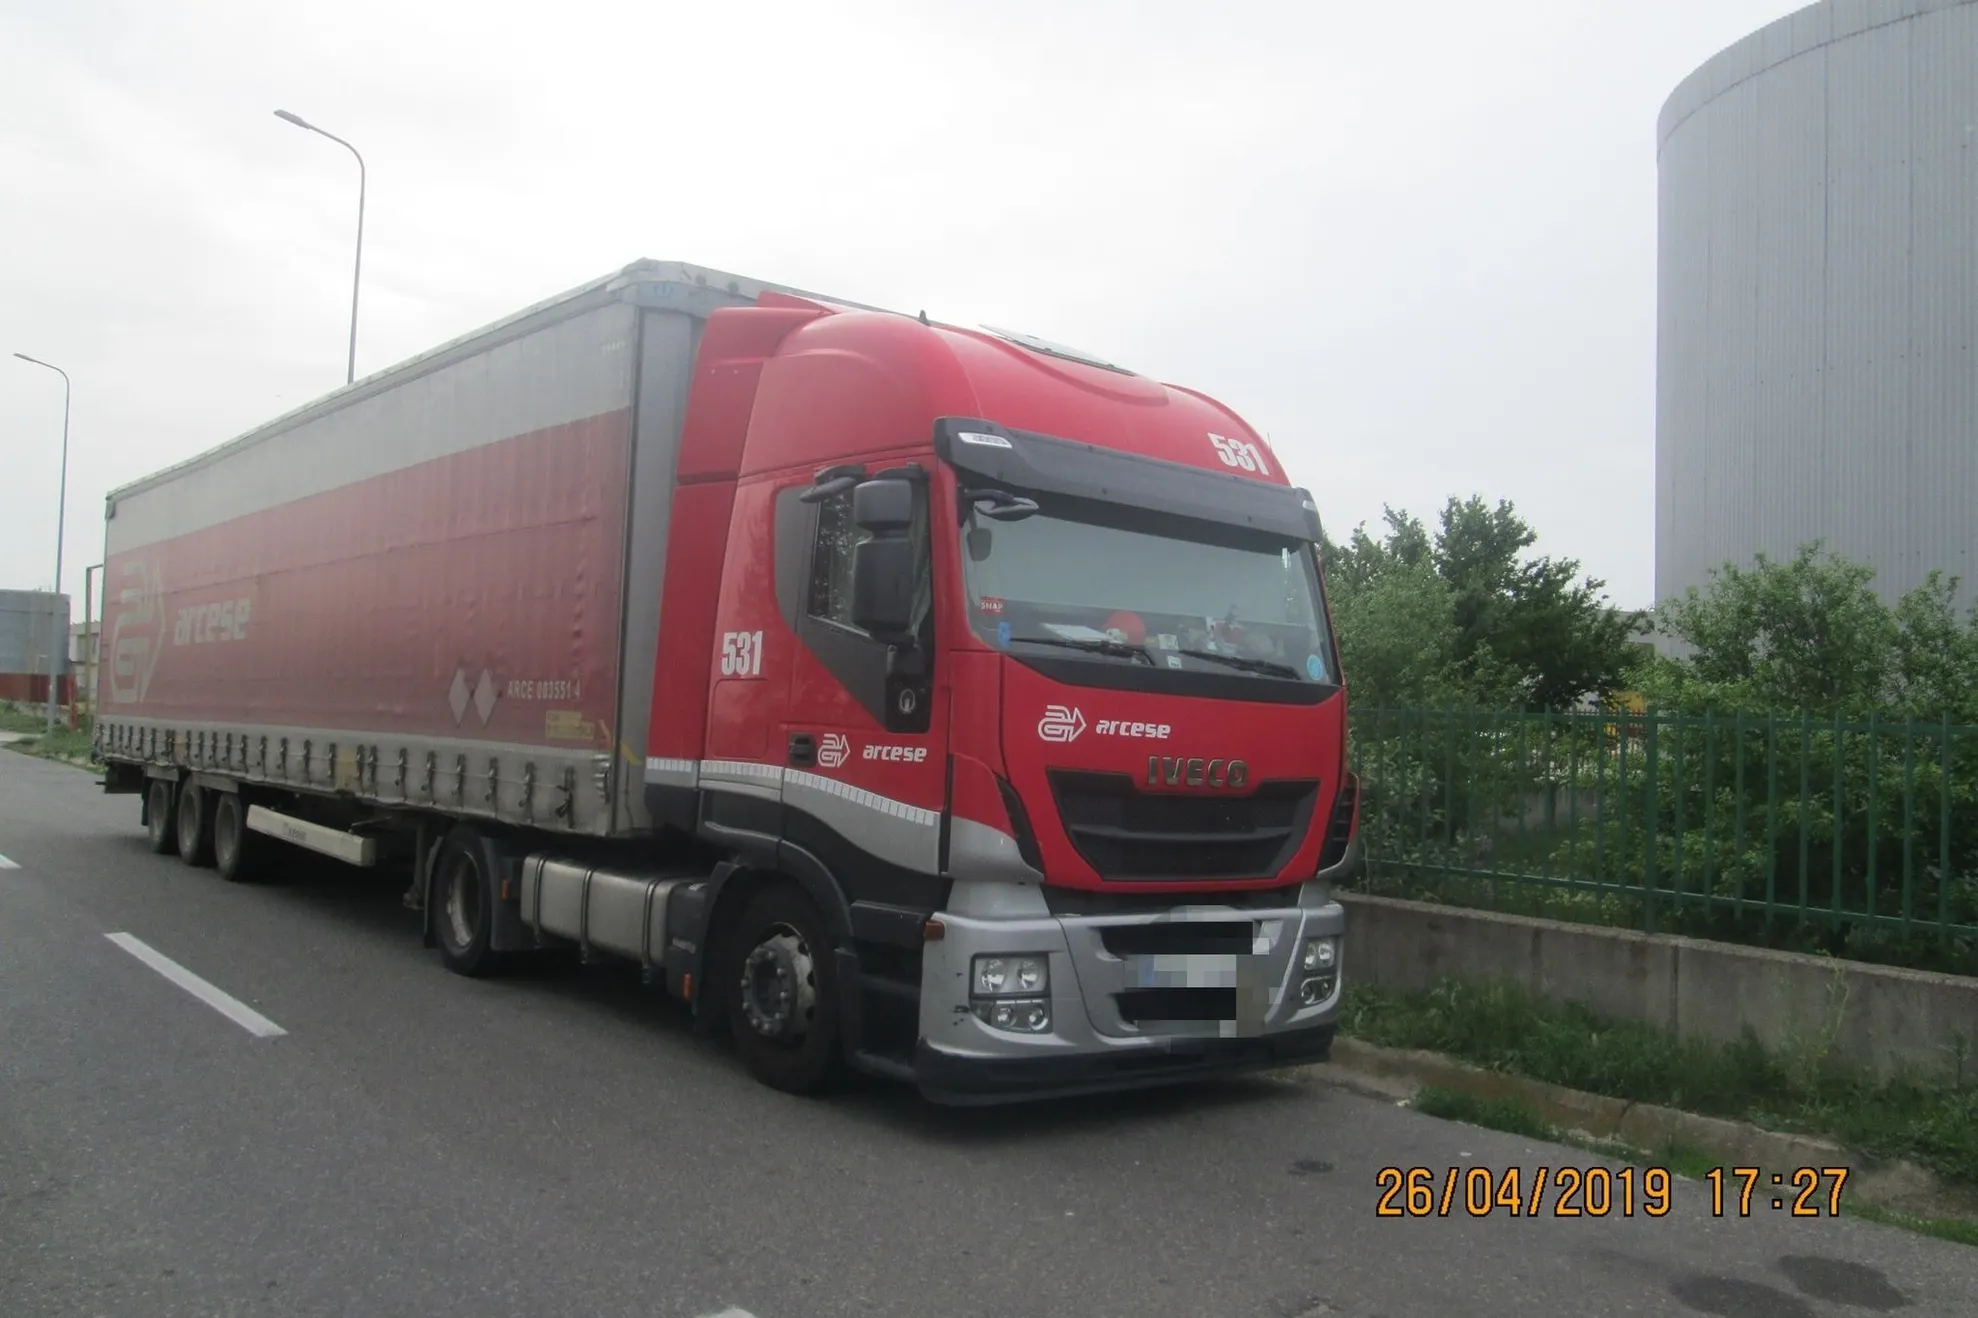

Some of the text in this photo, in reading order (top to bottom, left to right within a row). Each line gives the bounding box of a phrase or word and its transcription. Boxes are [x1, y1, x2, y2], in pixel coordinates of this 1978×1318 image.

[1208, 431, 1270, 475] 531
[174, 598, 250, 645] arcese
[721, 631, 763, 675] 531
[507, 680, 534, 699] ARCE
[1096, 719, 1171, 739] arcese
[862, 744, 927, 762] arcese
[1148, 755, 1248, 788] IVECO
